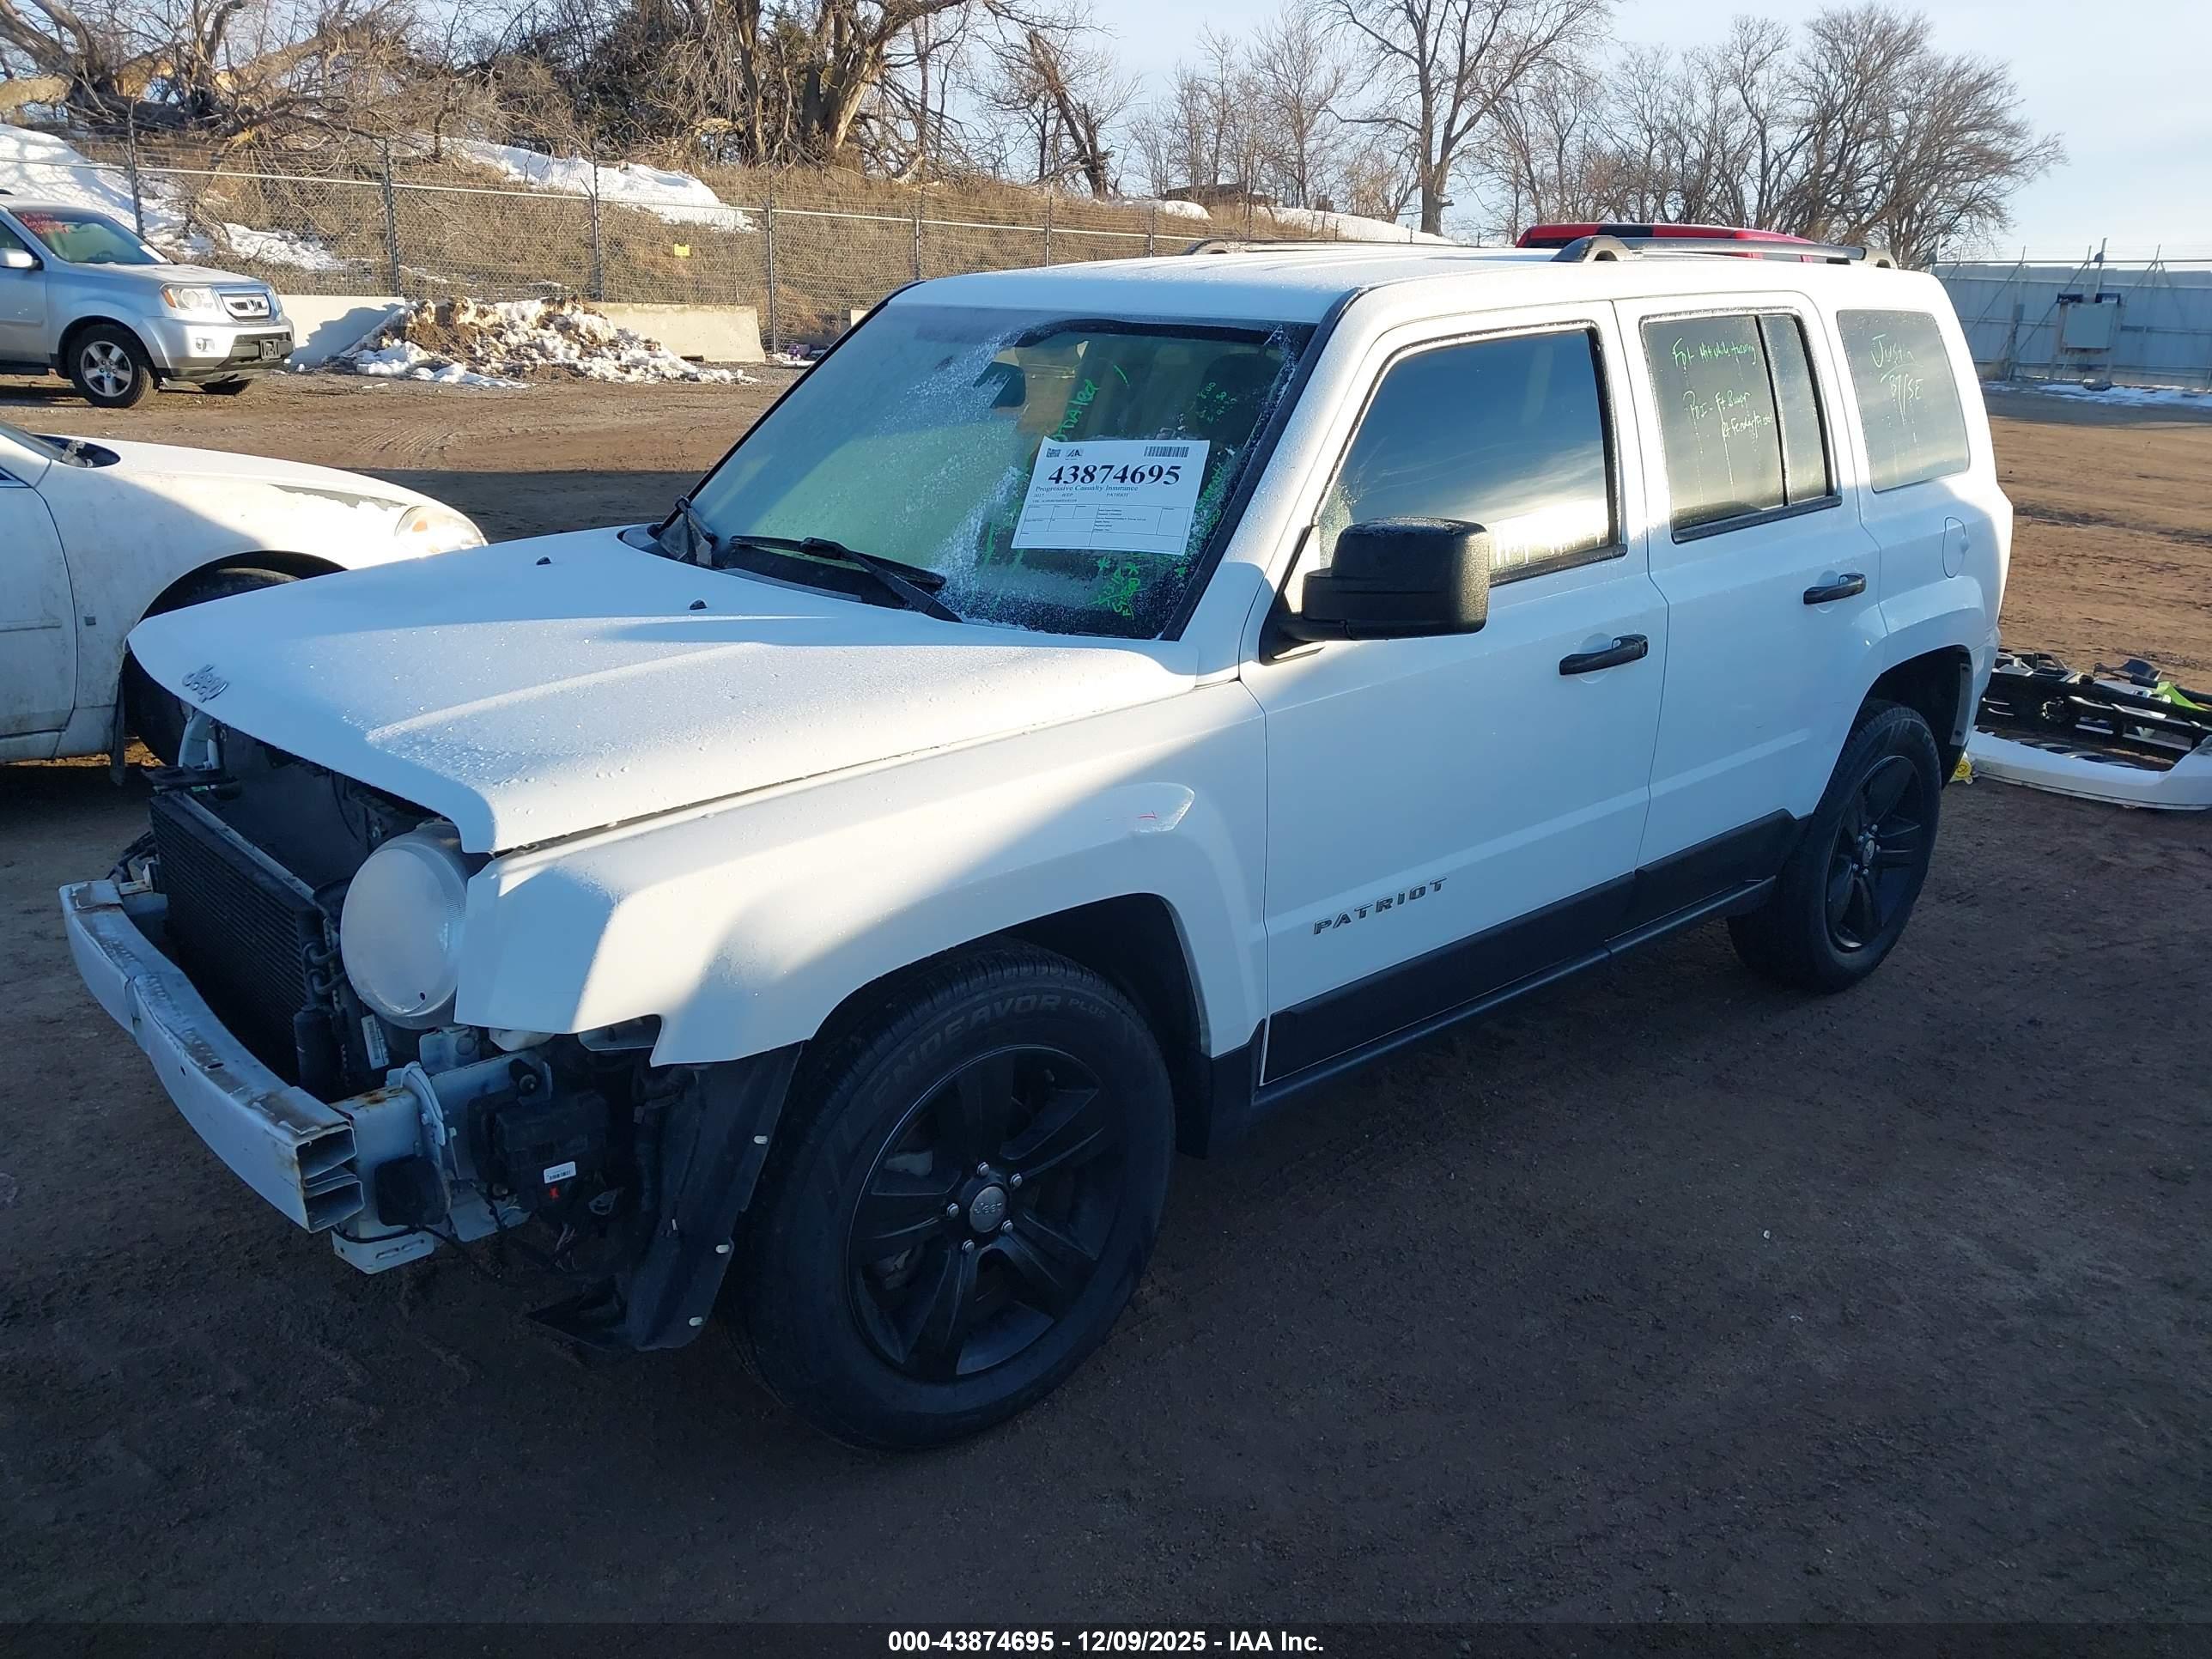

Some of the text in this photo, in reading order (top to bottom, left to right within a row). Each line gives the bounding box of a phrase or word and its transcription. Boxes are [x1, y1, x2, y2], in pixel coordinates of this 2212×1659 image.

[1048, 464, 1182, 485] 43874695
[181, 664, 228, 703] Jeep
[1313, 877, 1449, 935] PATRIOT
[872, 994, 1108, 1103] ENDEAVOR PLUS
